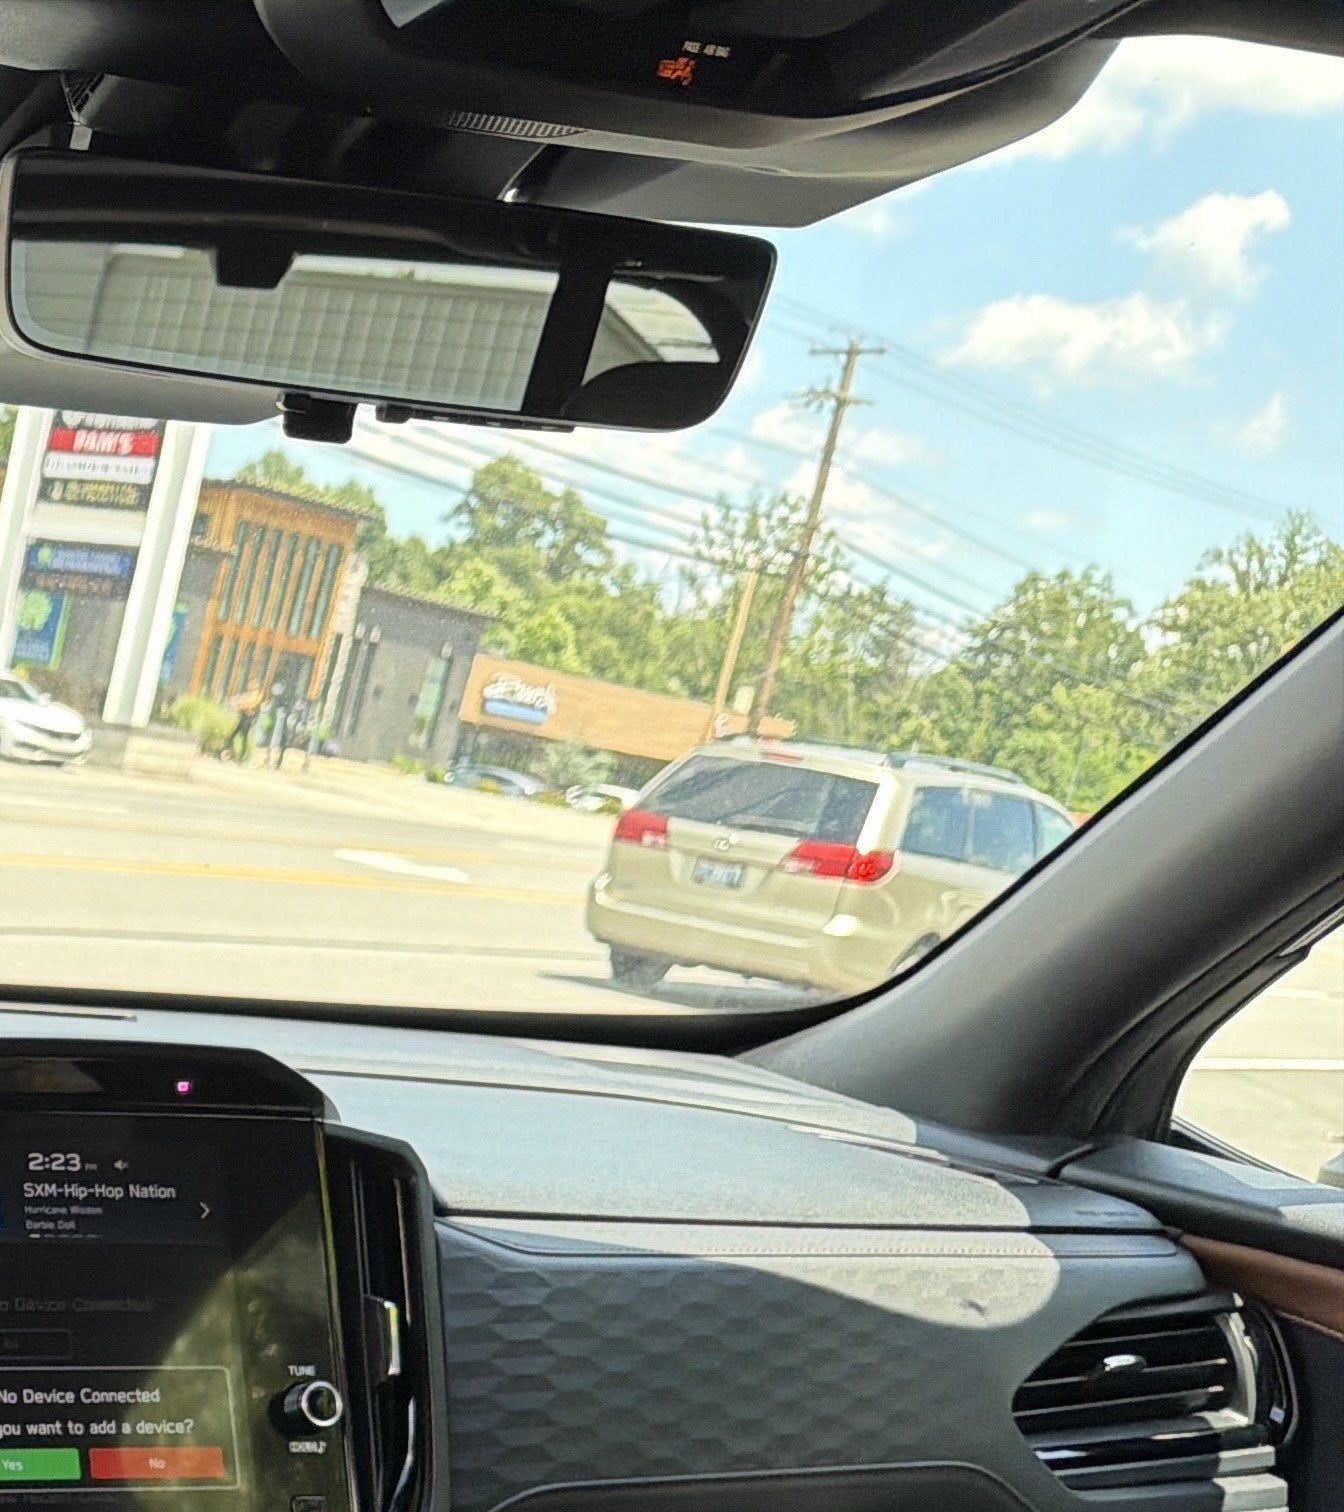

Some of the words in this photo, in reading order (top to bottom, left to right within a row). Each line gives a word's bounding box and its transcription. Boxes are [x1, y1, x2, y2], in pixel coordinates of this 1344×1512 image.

[27, 1153, 82, 1171] 2:23
[23, 1183, 124, 1201] SXM-Hip-Hop
[128, 1183, 177, 1199] Nation
[287, 1365, 316, 1377] TUNE
[23, 1388, 75, 1404] Device
[80, 1388, 160, 1404] Connected
[26, 1420, 62, 1435] want
[67, 1420, 84, 1435] to
[89, 1419, 116, 1434] add
[122, 1423, 132, 1434] a
[136, 1419, 193, 1434] device?
[2, 1459, 23, 1472] Yes
[148, 1458, 166, 1470] No
